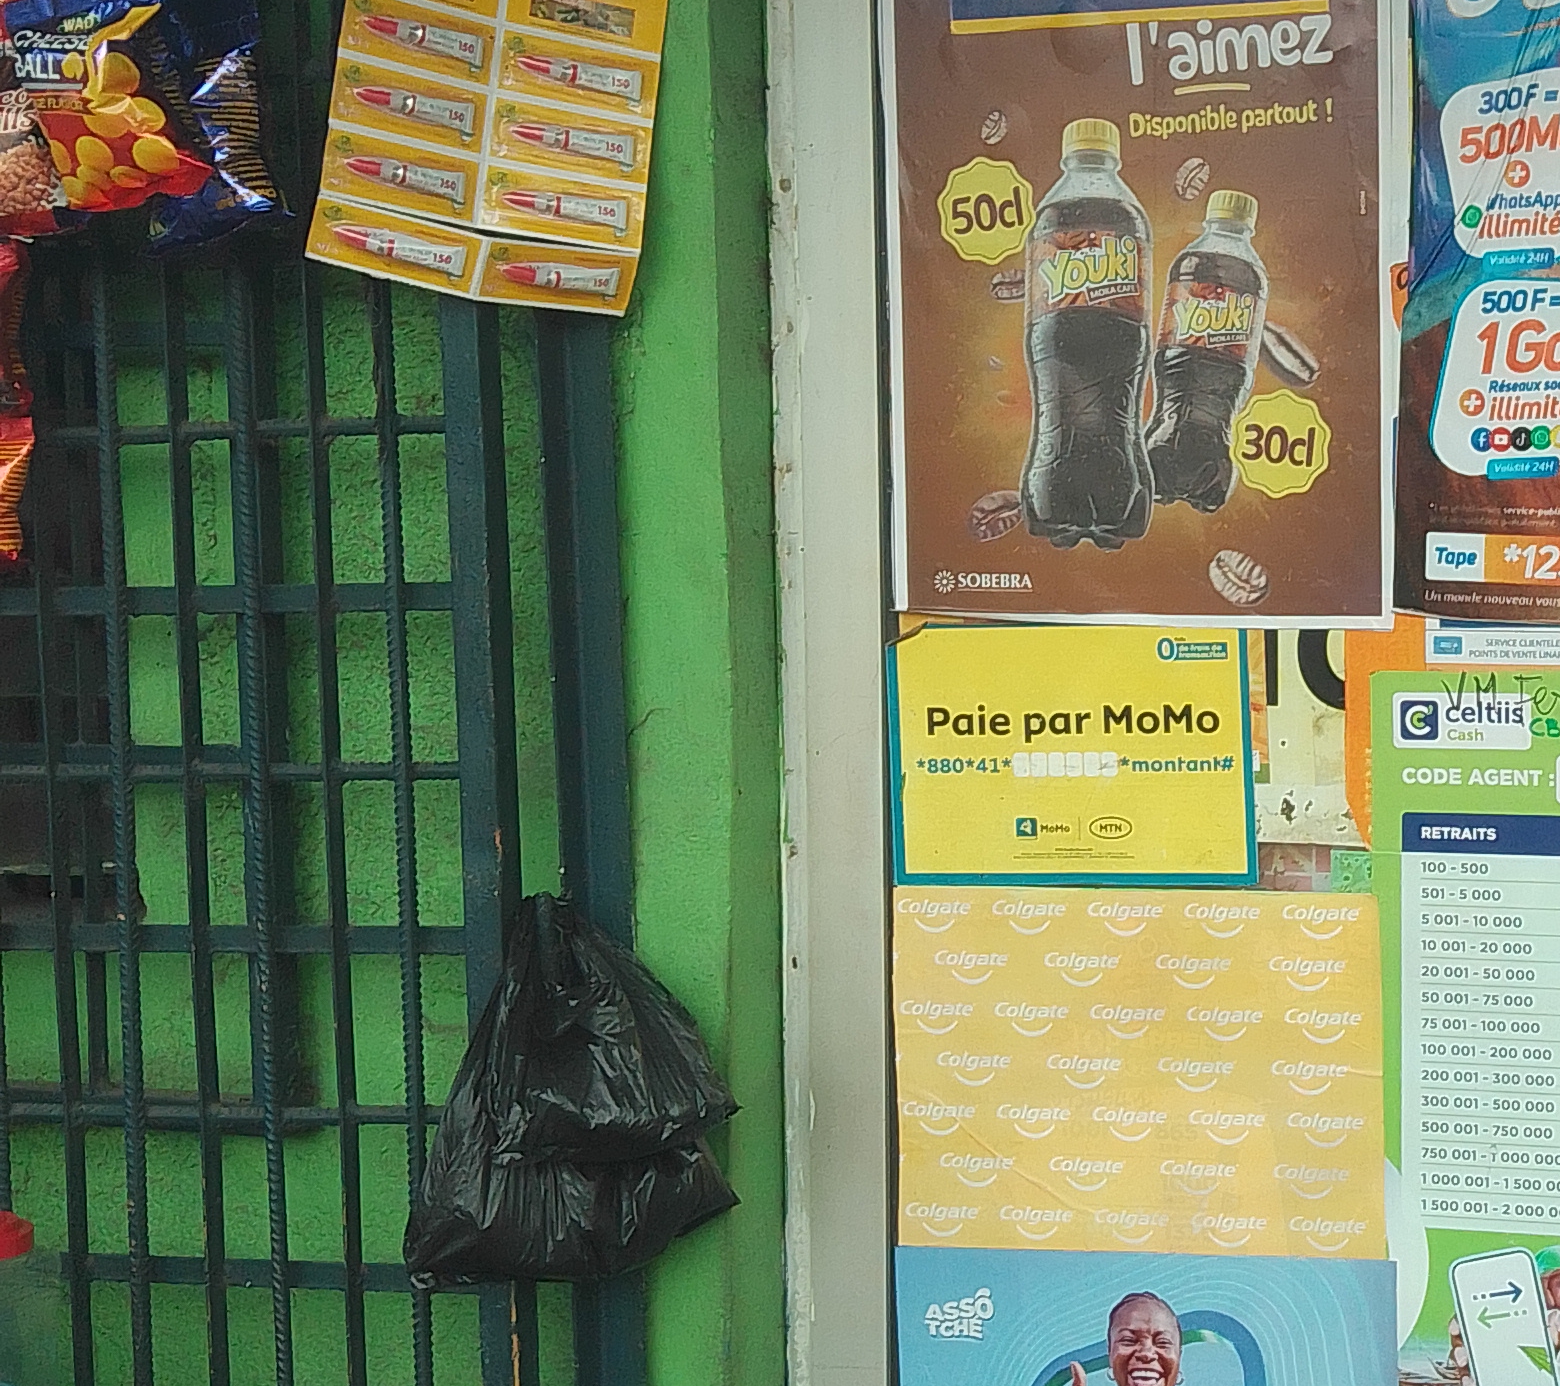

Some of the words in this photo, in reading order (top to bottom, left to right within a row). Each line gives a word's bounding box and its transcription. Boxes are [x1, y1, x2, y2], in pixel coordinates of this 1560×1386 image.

[458, 39, 475, 54] 150
[1125, 13, 1333, 86] l'aimez
[1478, 83, 1539, 114] 300F
[1128, 108, 1238, 140] Disponible
[1241, 101, 1318, 133] partout
[951, 186, 1024, 235] 50cl
[1039, 236, 1138, 303] Youki
[1173, 292, 1254, 338] Youki
[1488, 380, 1540, 393] Réseaux
[1241, 424, 1314, 467] 30cl
[1435, 546, 1477, 569] Tape
[958, 571, 1032, 590] SOBEBRA
[1424, 590, 1441, 601] Un
[1484, 594, 1533, 606] nouveau
[1485, 638, 1517, 647] SERVICE
[1519, 638, 1560, 648] CLIENTELE
[1468, 649, 1498, 659] POINTS
[1500, 650, 1511, 658] DE
[1512, 650, 1537, 659] VENTE
[926, 704, 1011, 736] Paie
[1024, 708, 1091, 742] par
[1103, 704, 1219, 736] MoMo
[1446, 701, 1524, 726] celtiis
[1447, 728, 1484, 742] Cash
[1402, 768, 1462, 786] CODE
[1468, 769, 1542, 787] AGENT
[1040, 824, 1070, 833] MoMo
[1099, 823, 1122, 833] MTN
[1420, 826, 1497, 841] RETRAITS
[1421, 861, 1447, 873] 100
[1460, 862, 1489, 875] 500
[1421, 888, 1445, 899] 501
[897, 898, 970, 916] Colgate
[991, 899, 1066, 917] Colgate
[1087, 901, 1163, 920] Colgate
[1184, 903, 1261, 921] Colgate
[1282, 904, 1360, 924] Colgate
